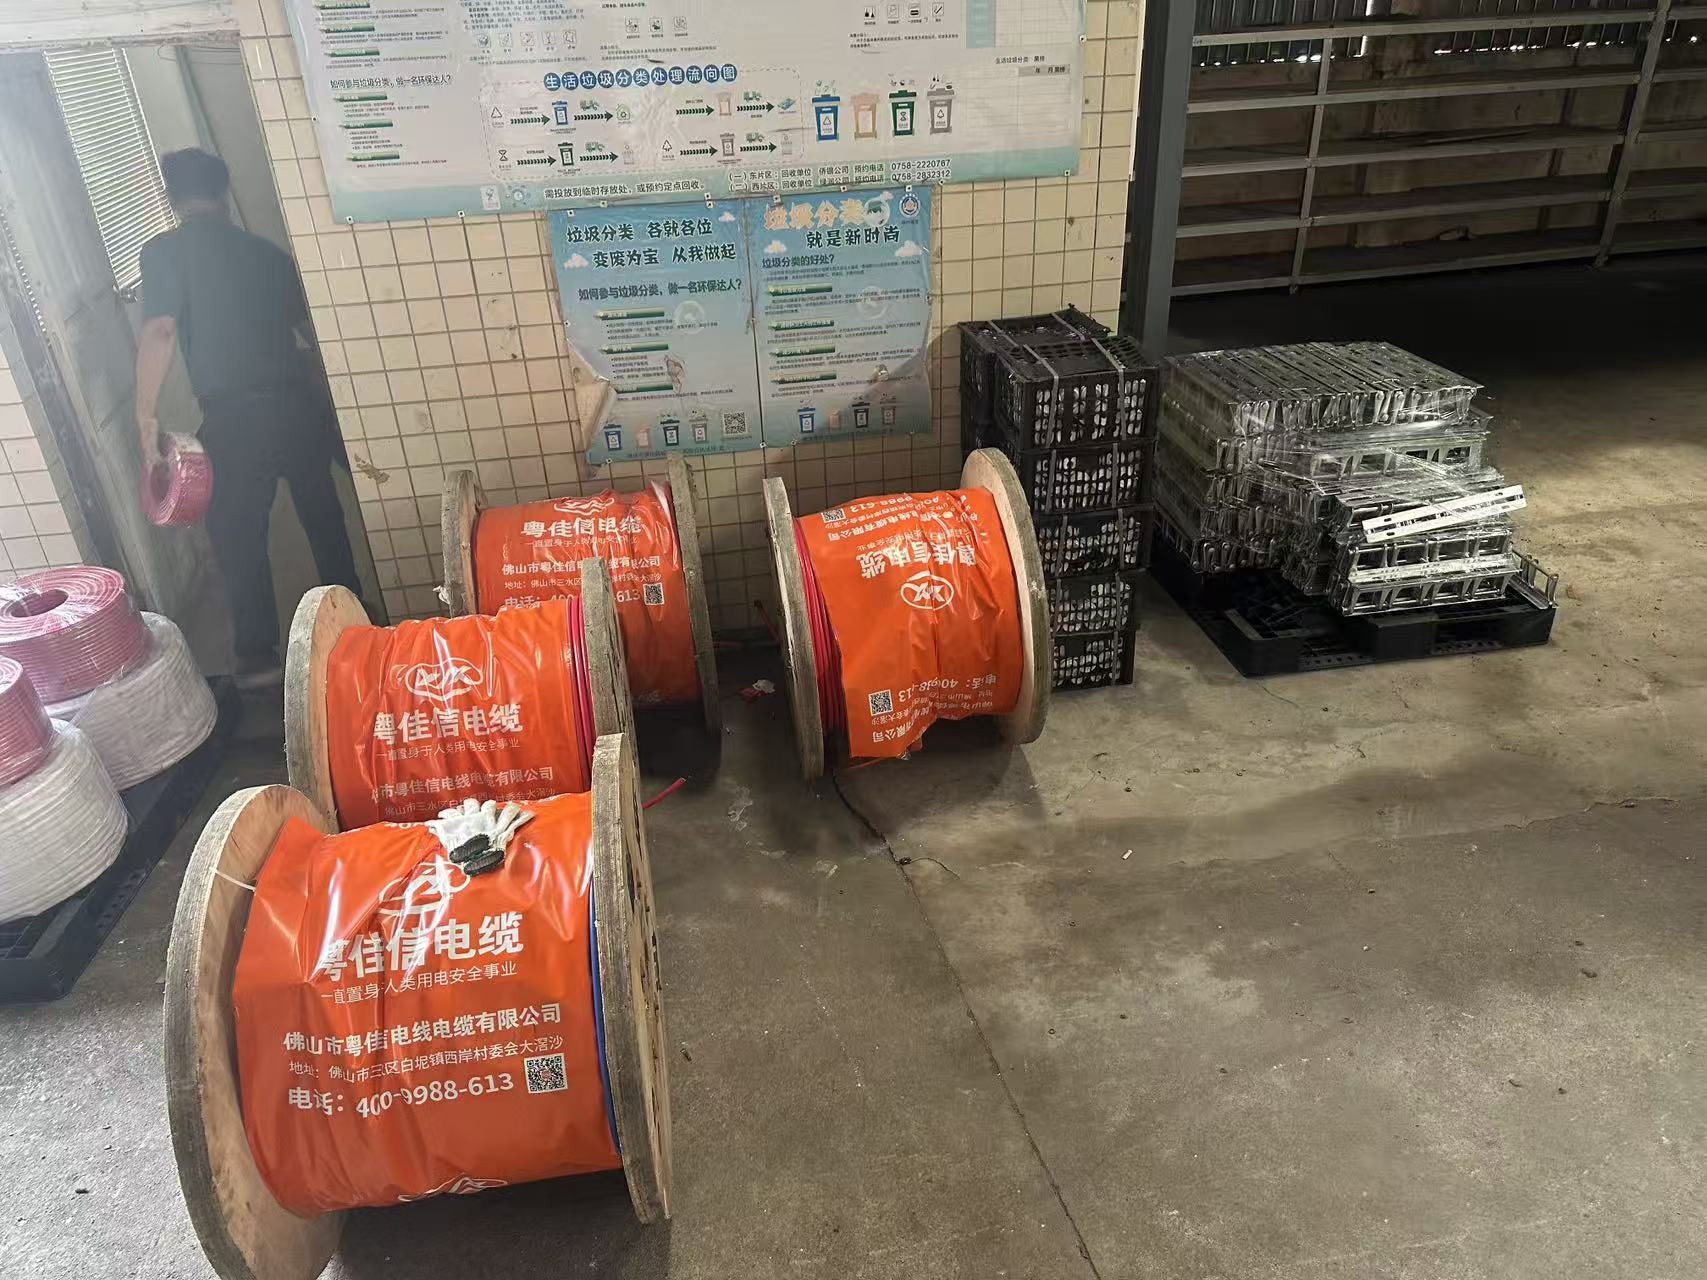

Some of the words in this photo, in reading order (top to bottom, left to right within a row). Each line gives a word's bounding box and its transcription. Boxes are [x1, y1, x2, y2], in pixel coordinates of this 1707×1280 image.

[545, 64, 737, 90] 生活垃圾分类处理流向图
[854, 163, 884, 173] 预约电话
[891, 169, 951, 181] 0758-2832312
[567, 223, 635, 243] 垃圾分类
[648, 217, 713, 239] 各就各位
[806, 225, 900, 249] 就是新时尚
[592, 248, 660, 269] 变废为宝
[672, 243, 737, 263] 从我做起
[521, 516, 642, 538] 粤佳信电缆
[856, 540, 976, 579] 粤佳信电缆
[373, 703, 523, 745] 粤佳信电缆
[321, 911, 524, 982] 粤佳信电缆
[321, 960, 518, 1004] 一直置身人类用电安全事业
[289, 1060, 320, 1079] 地址：
[328, 1035, 564, 1084] 佛山市三区白坭镇西岸村委会大滘沙
[356, 1072, 514, 1119] 400-9988-613
